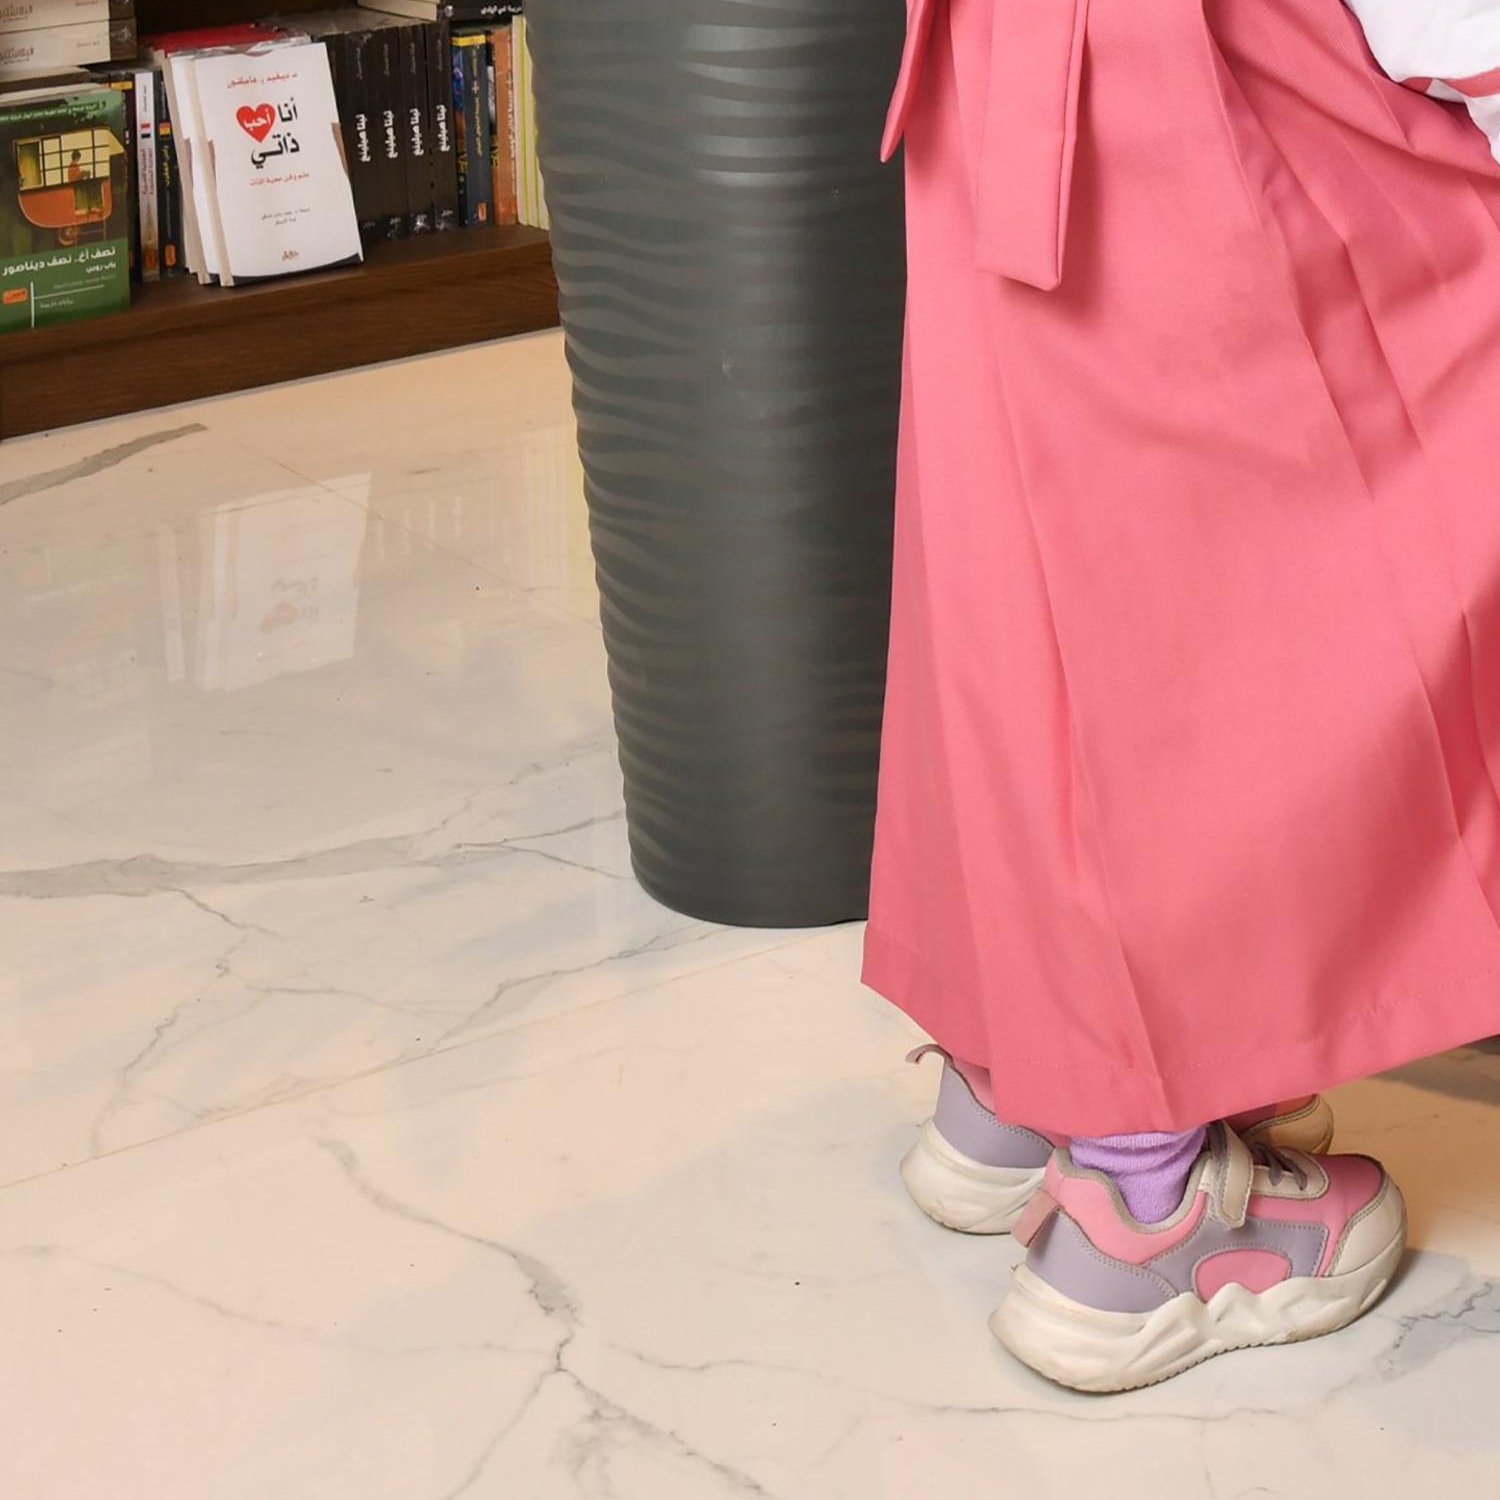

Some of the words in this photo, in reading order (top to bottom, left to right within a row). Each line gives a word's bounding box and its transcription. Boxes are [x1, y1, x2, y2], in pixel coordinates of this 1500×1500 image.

[277, 97, 299, 124] أنا
[242, 111, 272, 131] أحب
[251, 133, 301, 169] ذاتي
[47, 252, 73, 268] نصف
[94, 246, 117, 260] نصف
[2, 255, 46, 276] ديناصور
